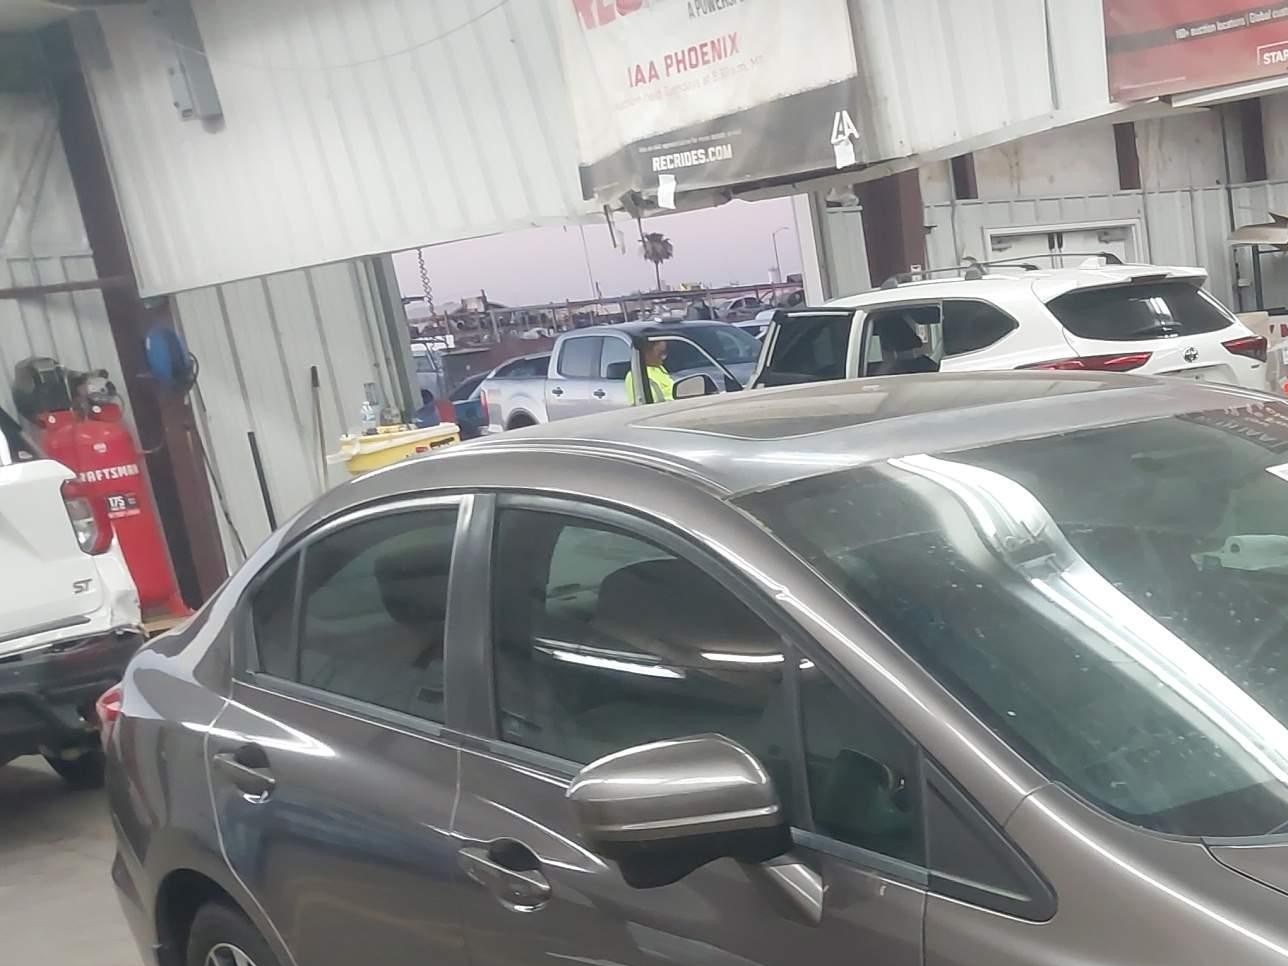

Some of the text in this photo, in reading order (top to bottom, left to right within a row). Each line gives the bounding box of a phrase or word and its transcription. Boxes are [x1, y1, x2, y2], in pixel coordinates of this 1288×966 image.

[627, 60, 661, 88] IAA
[663, 32, 740, 78] PHOENIX
[652, 144, 733, 172] RECRIDES.COM
[79, 463, 139, 483] RAFTSMAN
[72, 578, 93, 594] ST
